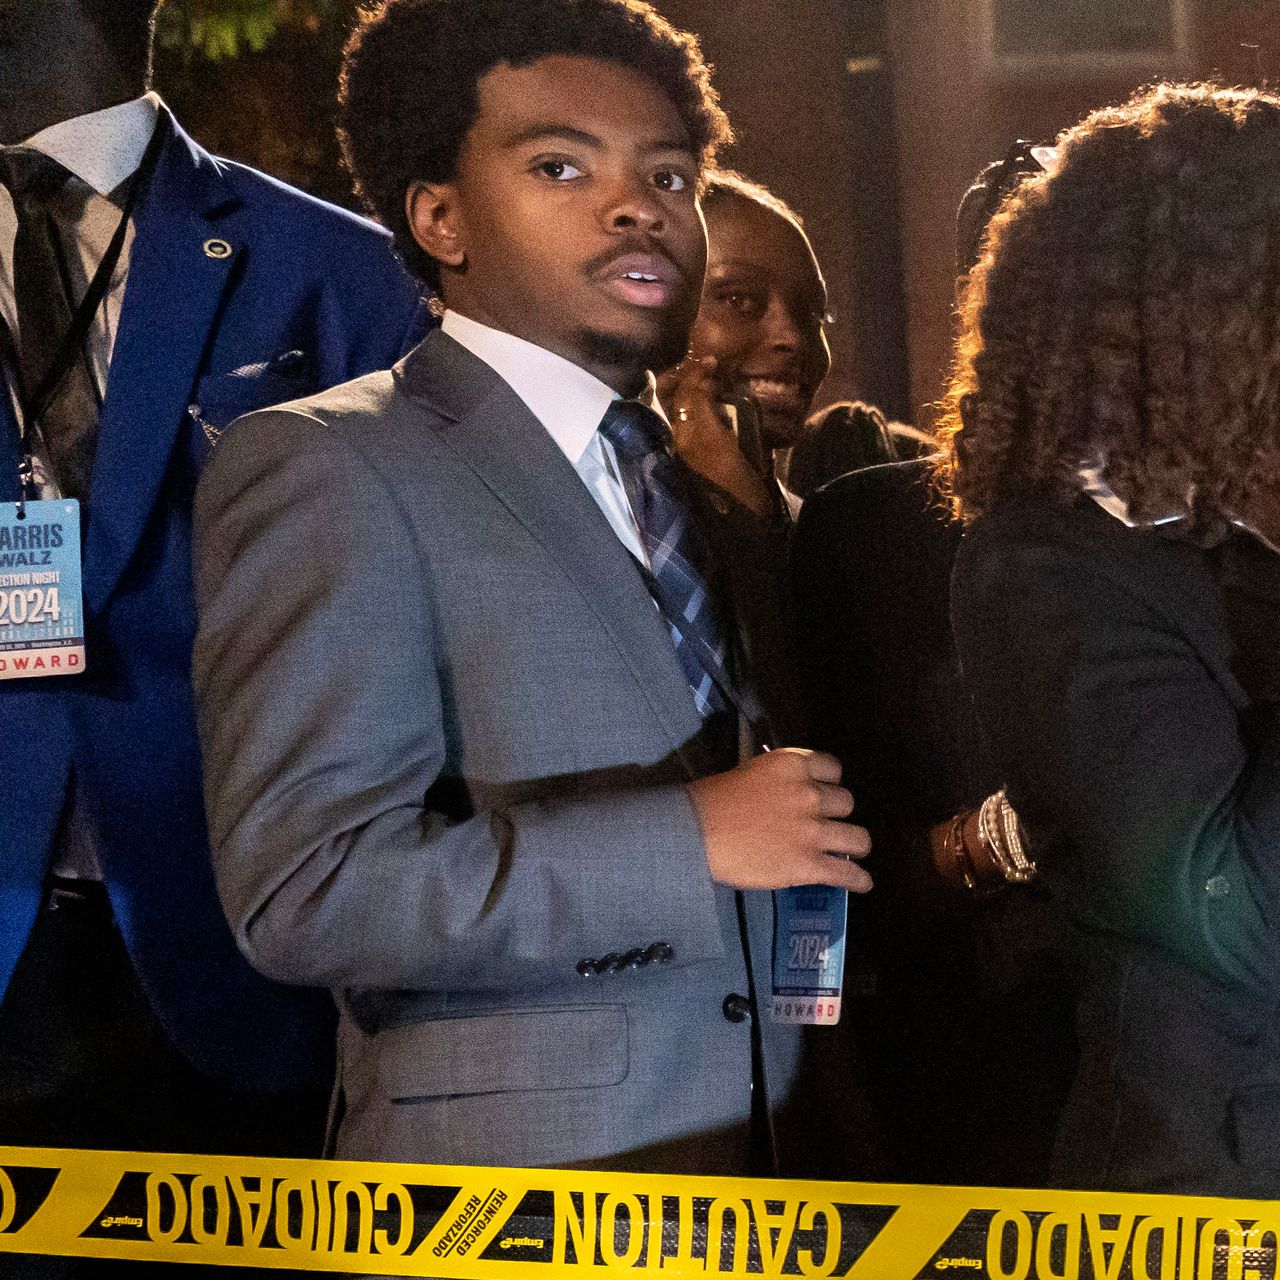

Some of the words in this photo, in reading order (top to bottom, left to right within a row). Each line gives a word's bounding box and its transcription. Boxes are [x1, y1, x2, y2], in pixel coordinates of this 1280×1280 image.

[147, 1172, 413, 1255] CUIDADO
[431, 1194, 481, 1257] REFORZADO
[456, 1189, 508, 1257] REINFORCED
[506, 1237, 544, 1249] Empire
[553, 1190, 841, 1277] CAUTION
[942, 1257, 983, 1269] Empire
